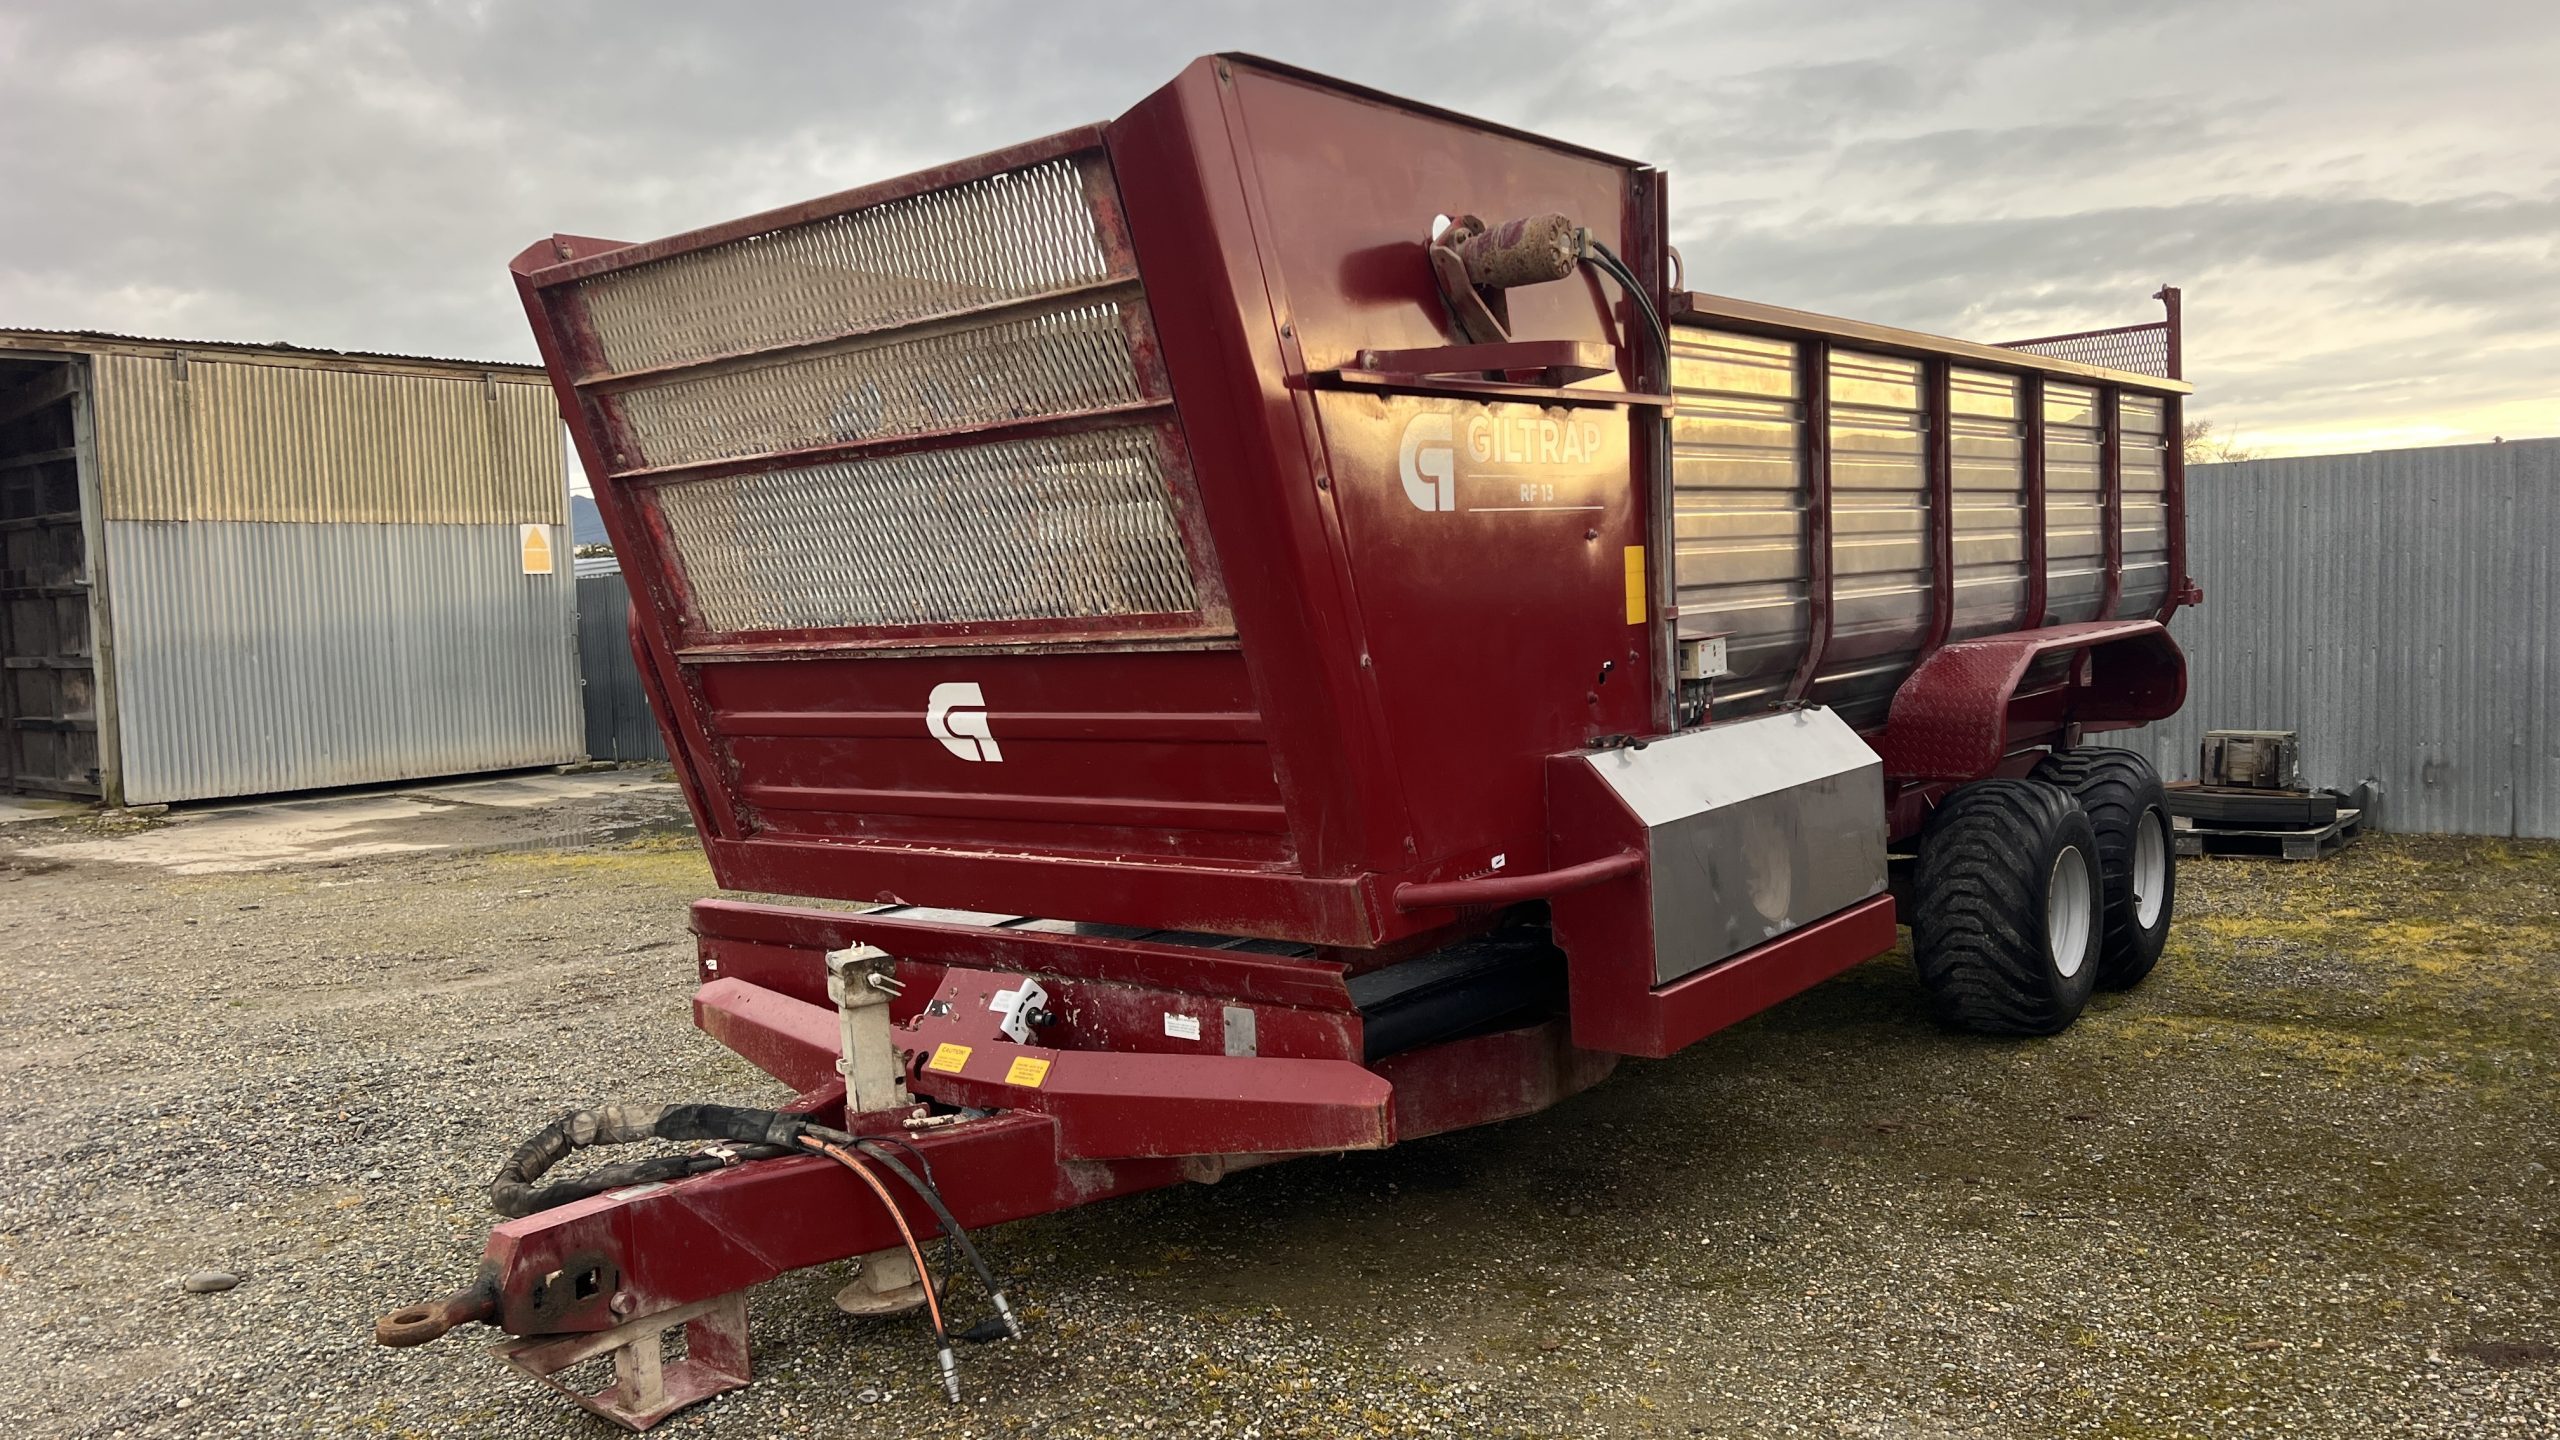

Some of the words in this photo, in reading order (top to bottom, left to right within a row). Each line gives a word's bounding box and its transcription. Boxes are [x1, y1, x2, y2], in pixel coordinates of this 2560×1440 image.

[1467, 415, 1600, 464] GILTRAP
[1520, 483, 1537, 502] RF
[1541, 484, 1554, 502] 13
